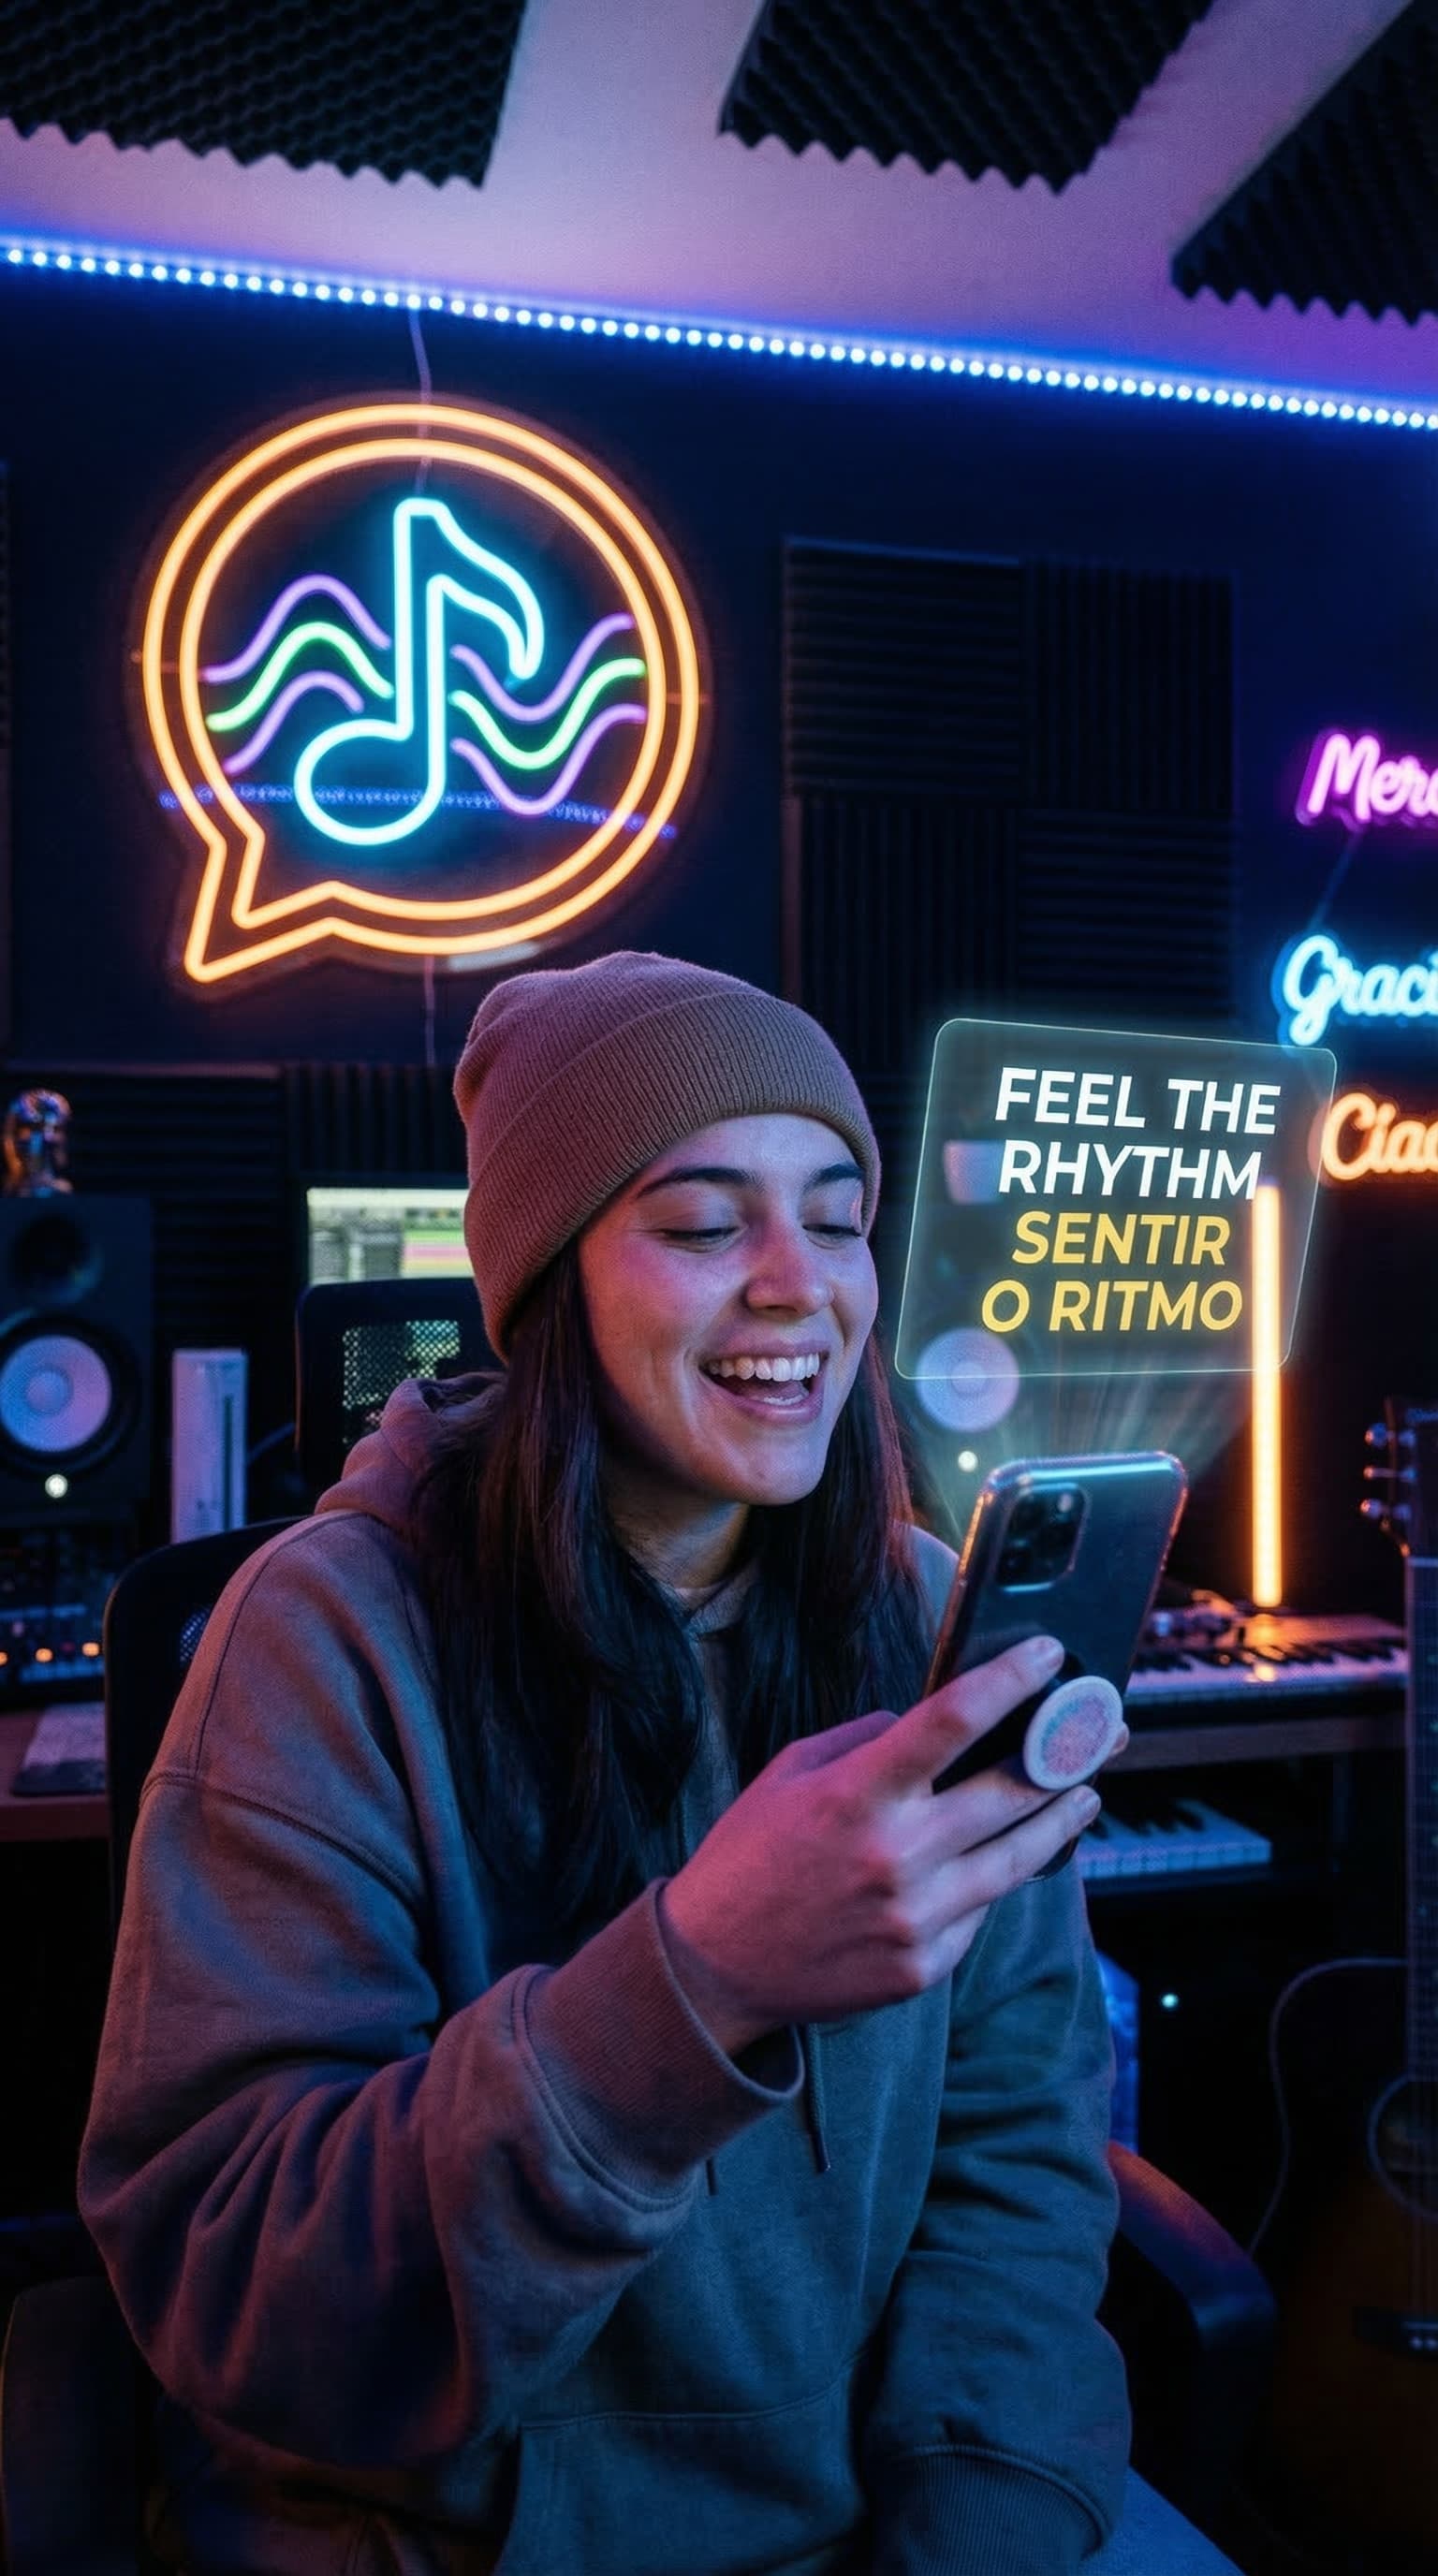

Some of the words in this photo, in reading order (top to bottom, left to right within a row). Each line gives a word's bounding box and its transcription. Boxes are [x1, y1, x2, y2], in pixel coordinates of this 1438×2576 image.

[995, 1067, 1146, 1128] FEEL
[1167, 1078, 1282, 1135] THE
[998, 1139, 1263, 1200] RHYTHM
[1012, 1211, 1231, 1266] SENTIR
[981, 1280, 1031, 1333] O
[1049, 1280, 1243, 1332] RITMO
